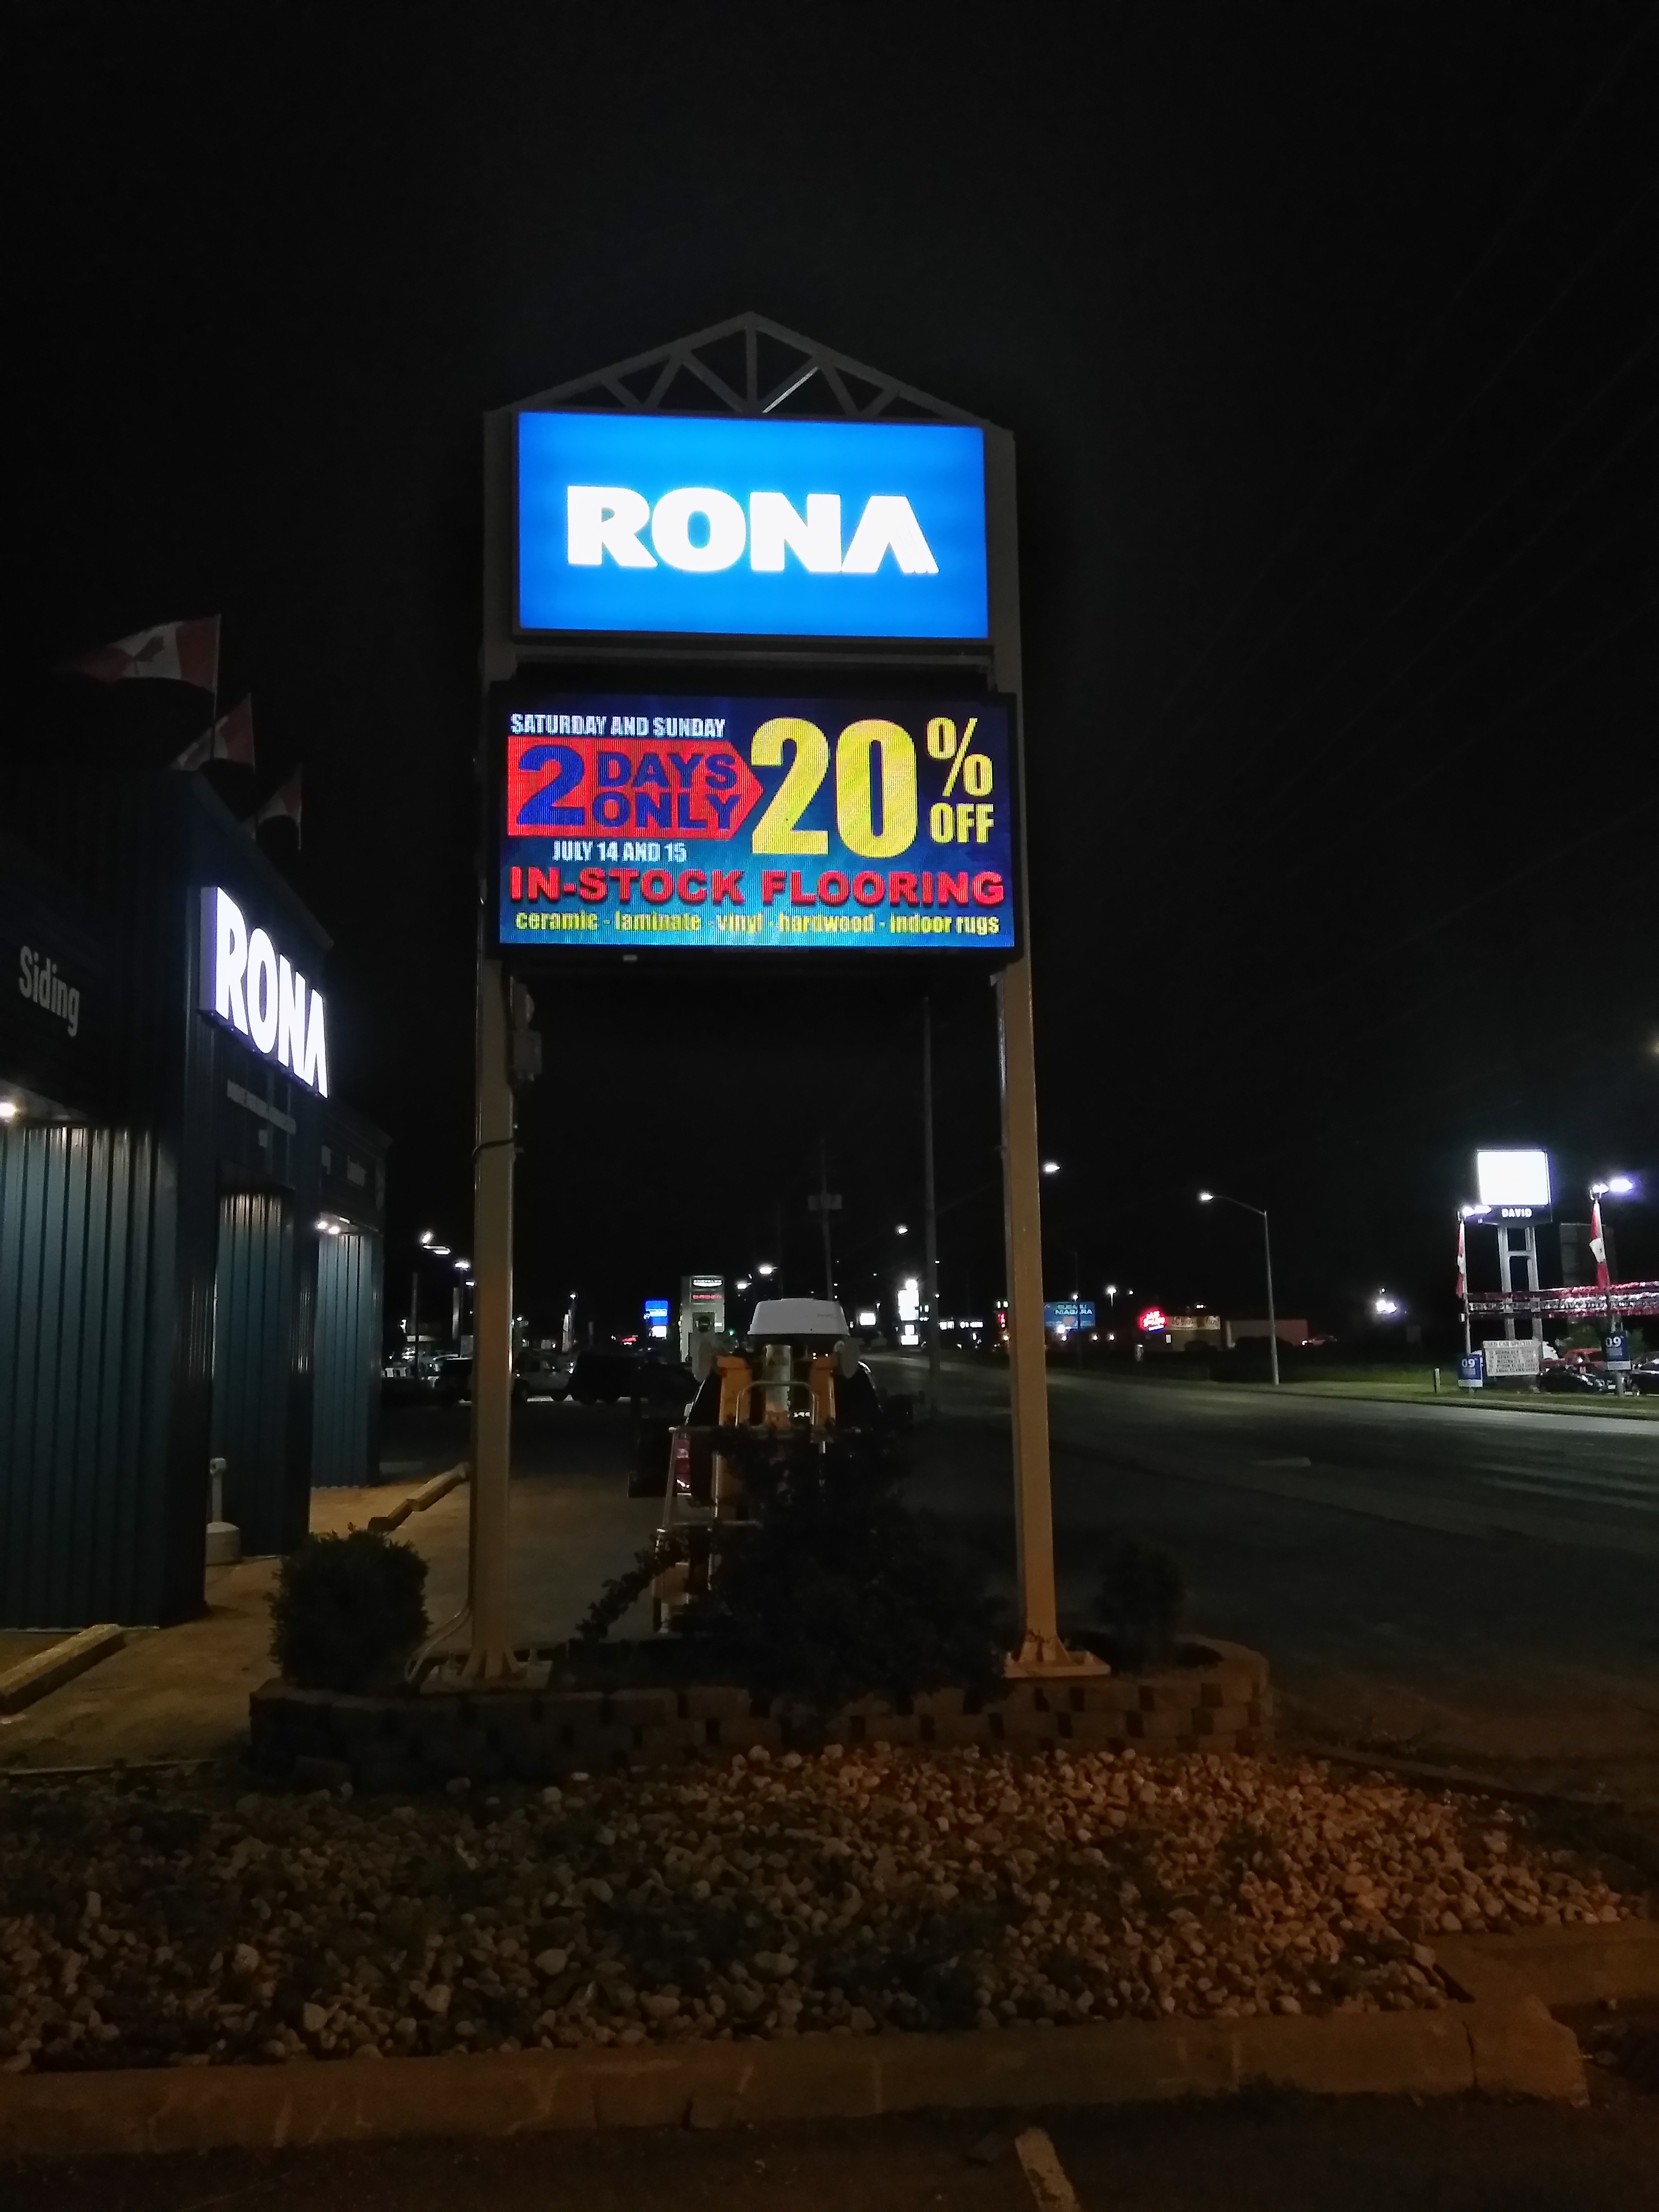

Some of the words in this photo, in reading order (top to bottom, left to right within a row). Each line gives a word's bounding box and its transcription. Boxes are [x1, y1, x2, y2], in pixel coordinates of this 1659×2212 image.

[567, 486, 939, 573] RONA
[510, 713, 607, 736] SATURDAY
[610, 716, 649, 736] AND
[653, 717, 726, 738] SUNDAY
[517, 745, 585, 826] 2
[598, 752, 738, 790] DAYS
[593, 791, 742, 830] ONLY
[930, 802, 994, 843] OFF
[553, 840, 593, 861] JULY
[597, 841, 618, 862] 14
[623, 842, 661, 862] AND
[664, 842, 687, 862] 15
[510, 866, 745, 904] IN-STOCK
[761, 869, 1005, 906] FLOORING
[515, 910, 598, 931] ceramic
[615, 911, 702, 931] laminate
[718, 912, 763, 934] vinyl
[779, 913, 875, 933] hardwood
[890, 914, 952, 934] indoor
[955, 915, 1000, 936] rugs
[19, 945, 80, 1038] Siding
[216, 886, 329, 1099] RONA
[1502, 1208, 1532, 1218] DAVID
